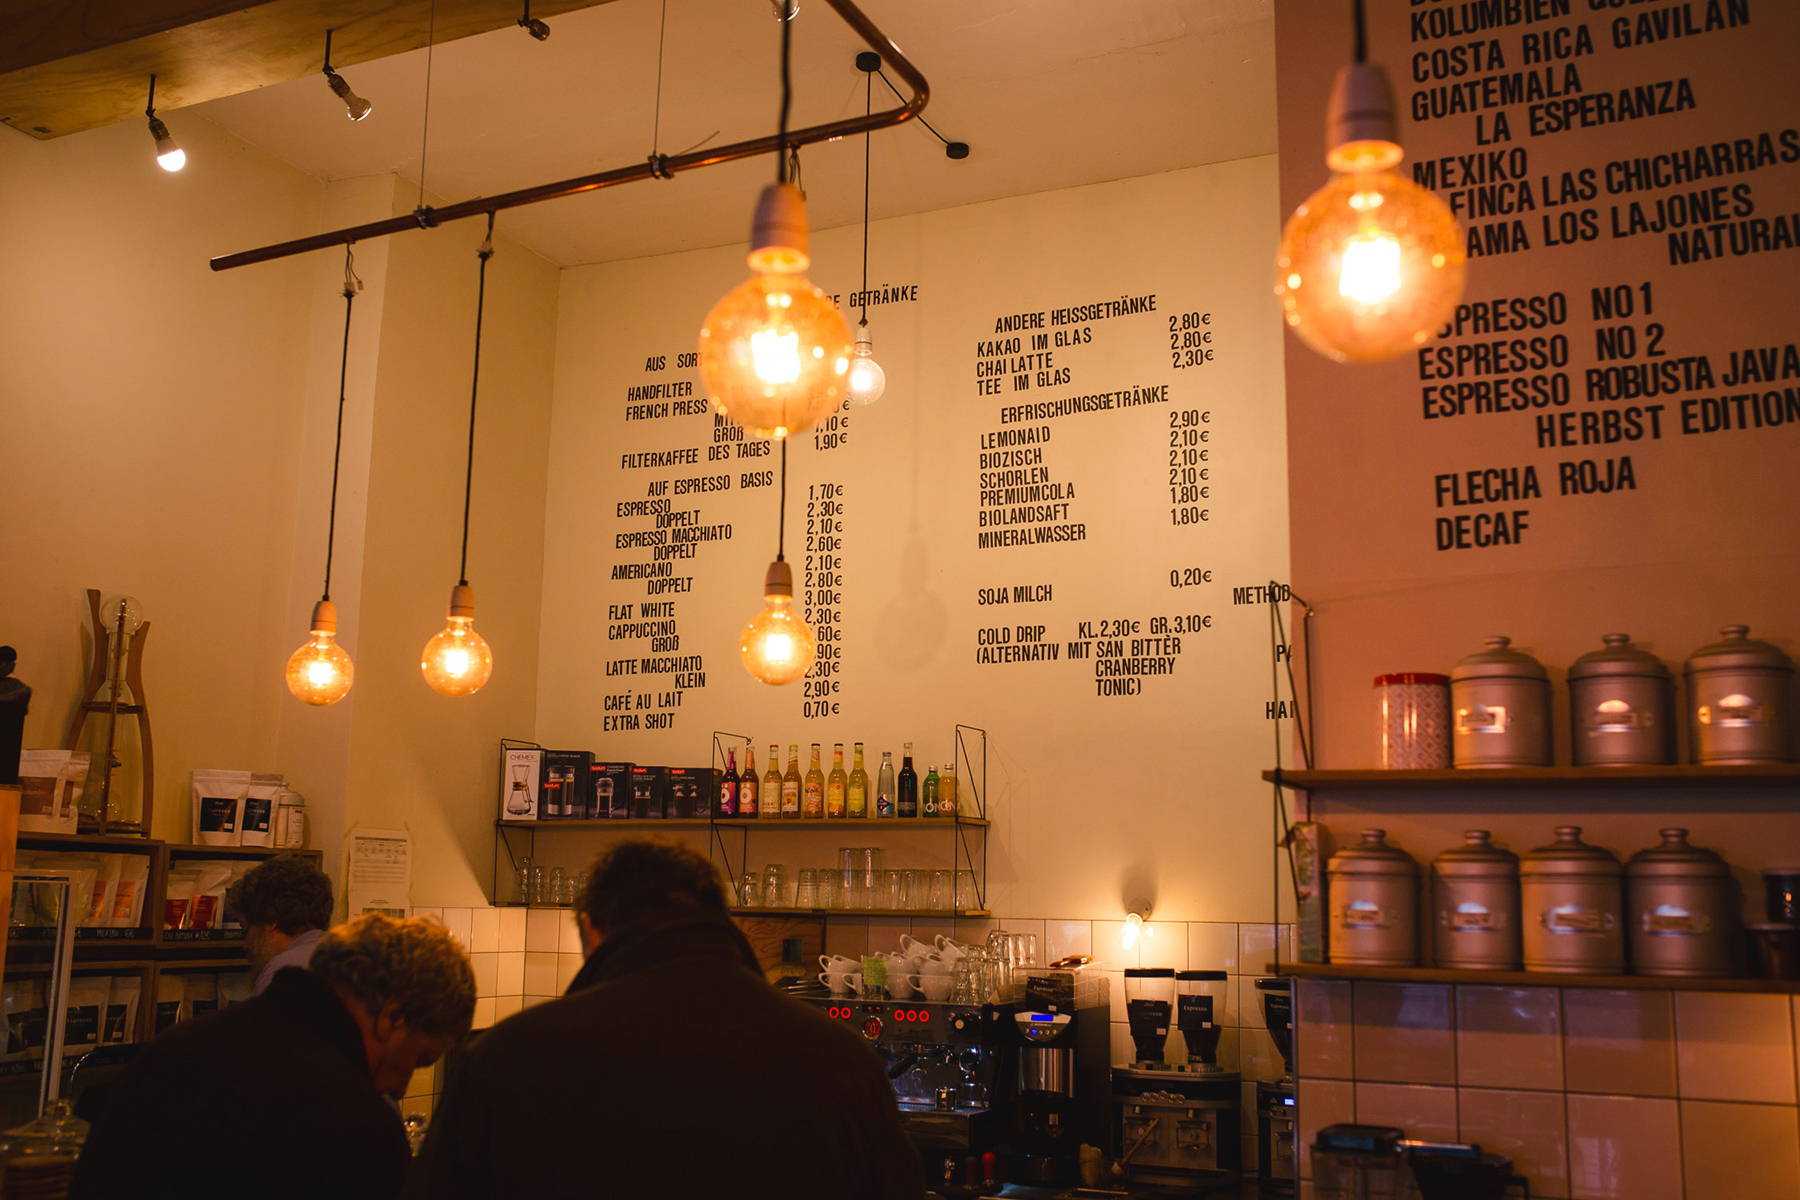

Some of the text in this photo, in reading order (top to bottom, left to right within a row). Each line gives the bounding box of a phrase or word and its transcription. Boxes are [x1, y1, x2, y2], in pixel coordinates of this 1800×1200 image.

[1412, 39, 1505, 83] COSTA
[1522, 24, 1594, 65] RICA
[1412, 62, 1582, 122] GUATEMALA
[1476, 78, 1696, 146] LA ESPERANZA
[1413, 147, 1527, 192] MEXIKO
[1449, 129, 1800, 220] FINCA LAS CHICHARRAS
[1542, 208, 1599, 247] LOS
[1611, 183, 1755, 239] LAJONES
[849, 284, 918, 308] GETRÄNKE
[995, 294, 1157, 333] ANDERE HEISSGETRÄNKE
[1169, 312, 1211, 332] 2,80€
[977, 327, 1092, 358] KAKAO IM GLAS
[1170, 331, 1213, 350] 2,80€
[645, 356, 666, 372] AUS
[976, 352, 1053, 378] CHAI LATTE
[1172, 349, 1214, 369] 2,30€
[1418, 334, 1568, 381] ESPRESSO
[627, 381, 692, 402] HANDFILTER
[977, 368, 1071, 396] TEE IM GLAS
[1422, 344, 1800, 420] ESPRESSO ROBUSTA JAVA
[625, 399, 708, 421] FRENCH PRESS
[1001, 385, 1169, 425] ERFRISCHUNGSGETRÄNKE
[1169, 409, 1211, 429] 2,90€
[1536, 405, 1664, 449] HERBST
[814, 433, 848, 452] 1,90€
[980, 426, 1051, 450] LEMONAID
[1169, 429, 1210, 449] 2,10€
[621, 440, 771, 469] FILTERKAFFEE DES TAGES
[979, 448, 1042, 470] BIOZISCH
[1169, 448, 1209, 468] 2,10€
[647, 471, 773, 497] AUF ESPRESSO BASIS
[980, 466, 1049, 489] SCHORLEN
[1169, 467, 1209, 487] 2,10€
[1434, 456, 1637, 508] FLECHA ROJA
[808, 483, 844, 501] 1,70€
[1170, 485, 1210, 505] 1,80€
[616, 499, 671, 518] ESPRESSO
[807, 501, 844, 518] 2,30€
[979, 503, 1069, 528] BIOLANDSAFT
[1170, 506, 1210, 526] 1,80€
[656, 510, 700, 529] DOPPELT
[807, 518, 843, 536] 2,10€
[615, 524, 732, 549] ESPRESSO MACCHIATO
[978, 524, 1086, 549] MINERALWASSER
[1436, 510, 1530, 551] DECAF
[653, 543, 698, 561] DOPPELT
[806, 536, 842, 553] 2,60€
[611, 562, 673, 580] AMERICANO
[805, 554, 842, 572] 2,10€
[647, 577, 693, 595] DOPPELT
[804, 571, 843, 589] 2,80€
[1170, 568, 1212, 589] 0,20€
[804, 589, 841, 607] 3,00€
[978, 584, 1053, 606] SOJA MILCH
[608, 601, 675, 620] FLAT WHITE
[804, 608, 841, 626] 2,30€
[608, 620, 676, 641] CAPPUCCINO
[978, 627, 1011, 646] COLD
[1016, 625, 1046, 643] DRIP
[976, 634, 1181, 665] (ALTERNATIV MIT SAN BITTÈR
[606, 655, 702, 676] LATTE MACCHIATO
[1095, 657, 1176, 677] CRANBERRY
[674, 672, 706, 690] KLEIN
[803, 680, 840, 700] 2,90€
[1095, 678, 1141, 697] TONIC)
[604, 689, 683, 711] CAFÉ AU LAIT
[803, 700, 840, 719] 0,70€
[603, 712, 675, 732] EXTRA SHOT
